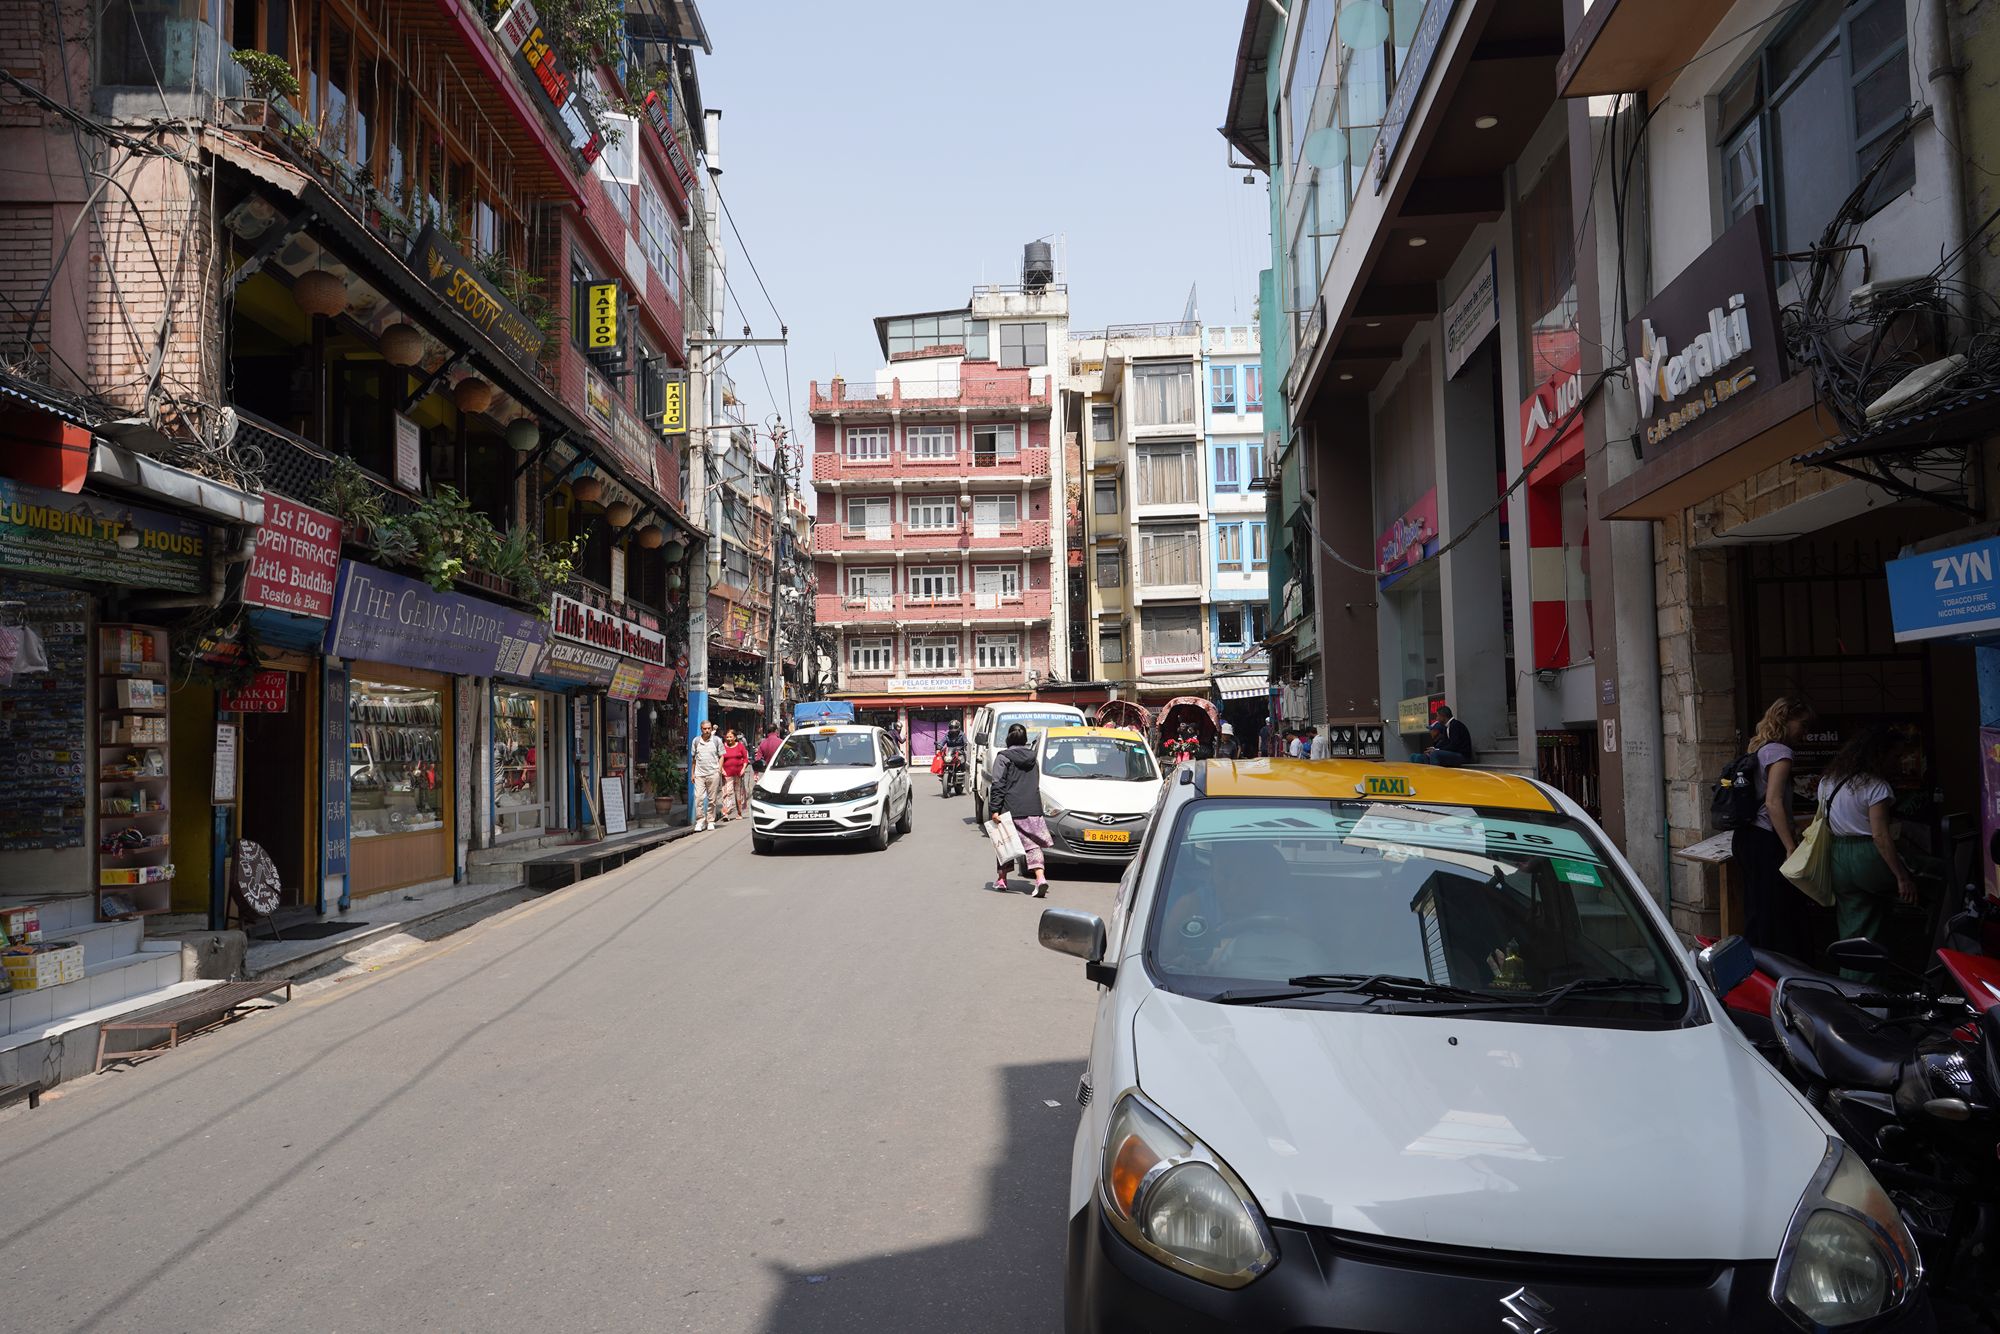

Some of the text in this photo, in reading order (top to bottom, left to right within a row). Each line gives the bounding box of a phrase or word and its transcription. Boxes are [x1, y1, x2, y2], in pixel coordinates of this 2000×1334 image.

[504, 20, 521, 47] KITCHEN
[447, 268, 504, 332] SCOOTY
[596, 288, 610, 344] TATTOO
[668, 385, 680, 430] TATTO
[0, 500, 93, 537] LUMBINI
[143, 527, 204, 556] HOUSE
[271, 503, 333, 541] 1st Floor
[257, 527, 337, 568] OPEN TERRACE
[250, 555, 333, 596] Little Buddha
[1932, 549, 1992, 590] ZYN
[260, 584, 320, 611] Resto & Bar
[352, 575, 395, 620] THE
[398, 589, 450, 634] GEM'S
[451, 602, 504, 645] EMPIRE
[1938, 602, 1997, 618] NICOTINE POUCHES
[1943, 593, 1988, 607] TOBACCO FREE
[555, 597, 584, 638] Little
[585, 609, 621, 649] Buddha
[622, 622, 664, 663] Restaurant
[552, 644, 583, 664] GEM'S
[582, 651, 617, 671] GALLERY
[1154, 656, 1179, 665] THANKA
[263, 672, 284, 688] Top
[1051, 714, 1080, 722] SUPPLIERS
[1803, 730, 1839, 741] eraki
[1369, 778, 1405, 793] TAXI
